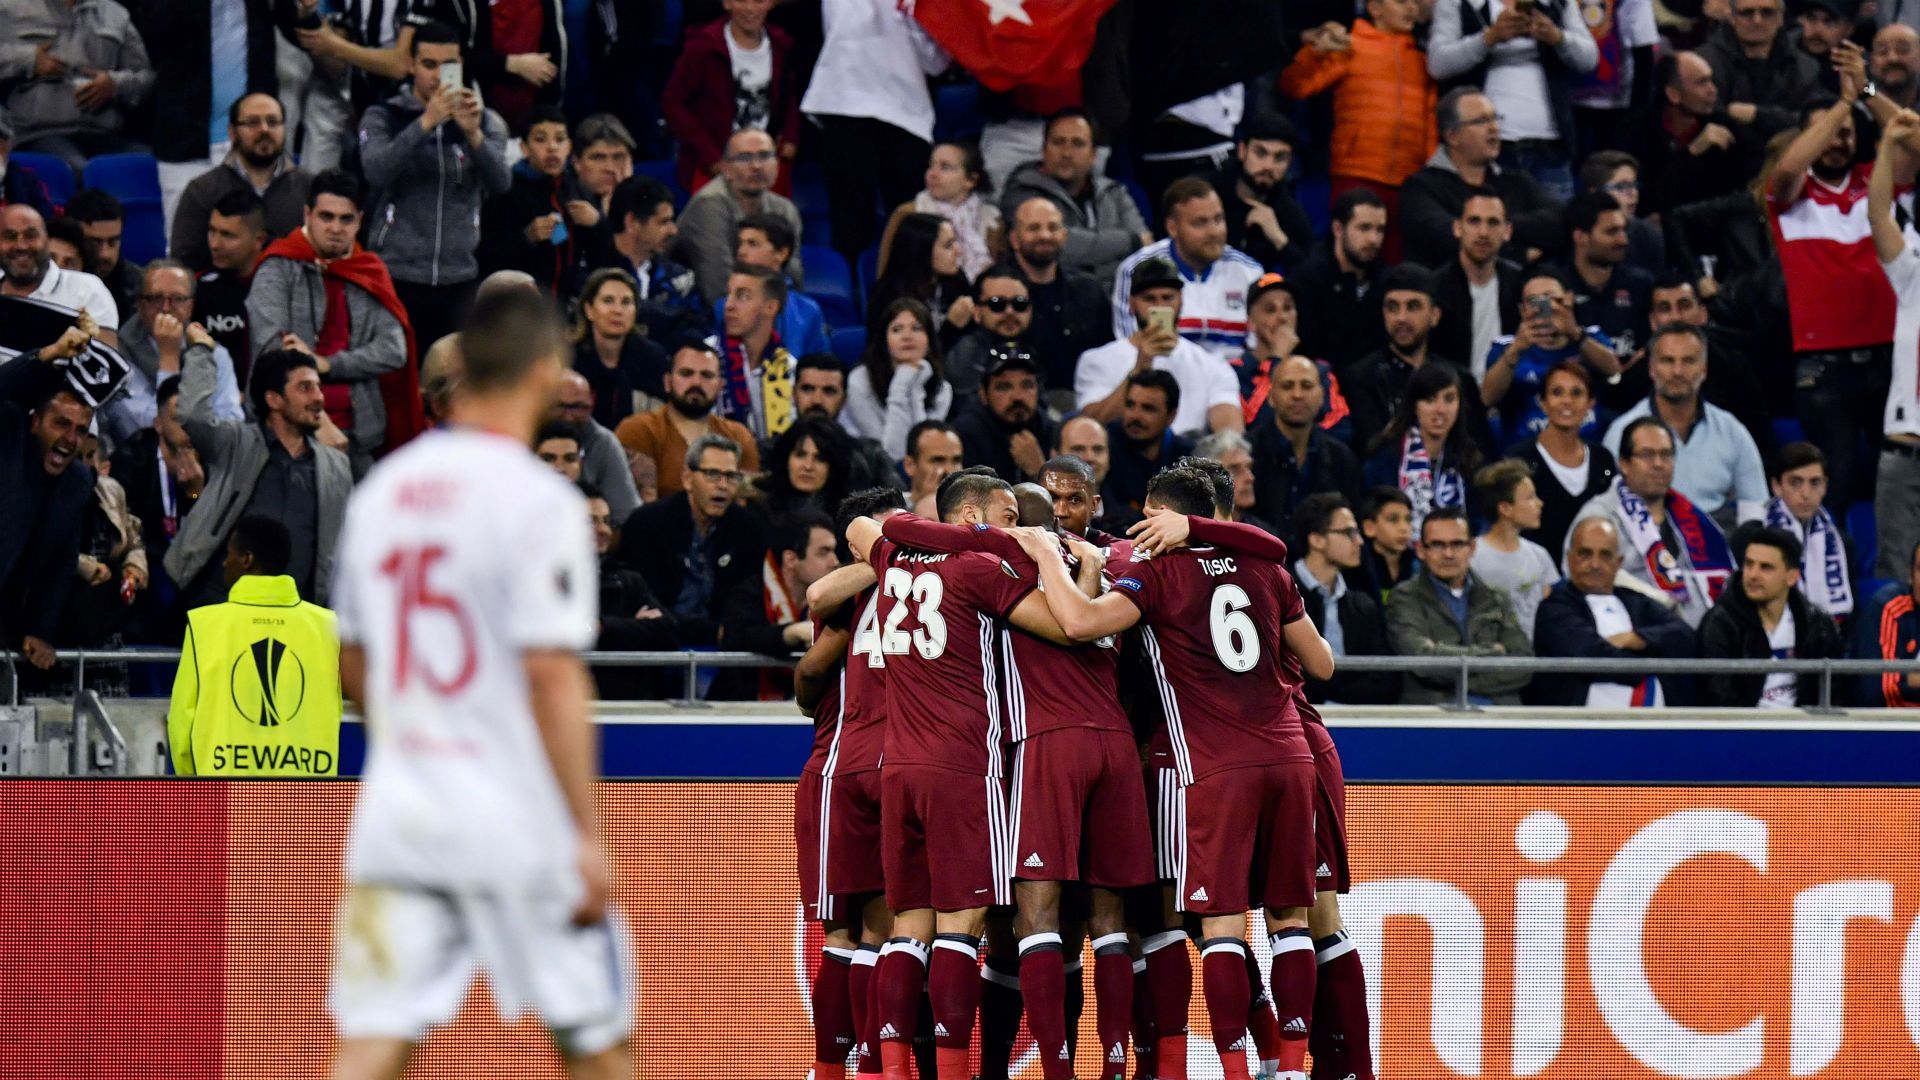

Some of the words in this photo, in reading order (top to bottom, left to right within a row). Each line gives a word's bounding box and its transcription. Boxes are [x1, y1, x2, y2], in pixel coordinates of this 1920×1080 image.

[1197, 557, 1238, 577] TOSIC
[378, 543, 480, 696] 15
[852, 585, 886, 669] 4
[881, 567, 948, 660] 23
[1209, 583, 1261, 673] 6
[1250, 807, 1920, 1080] niCr
